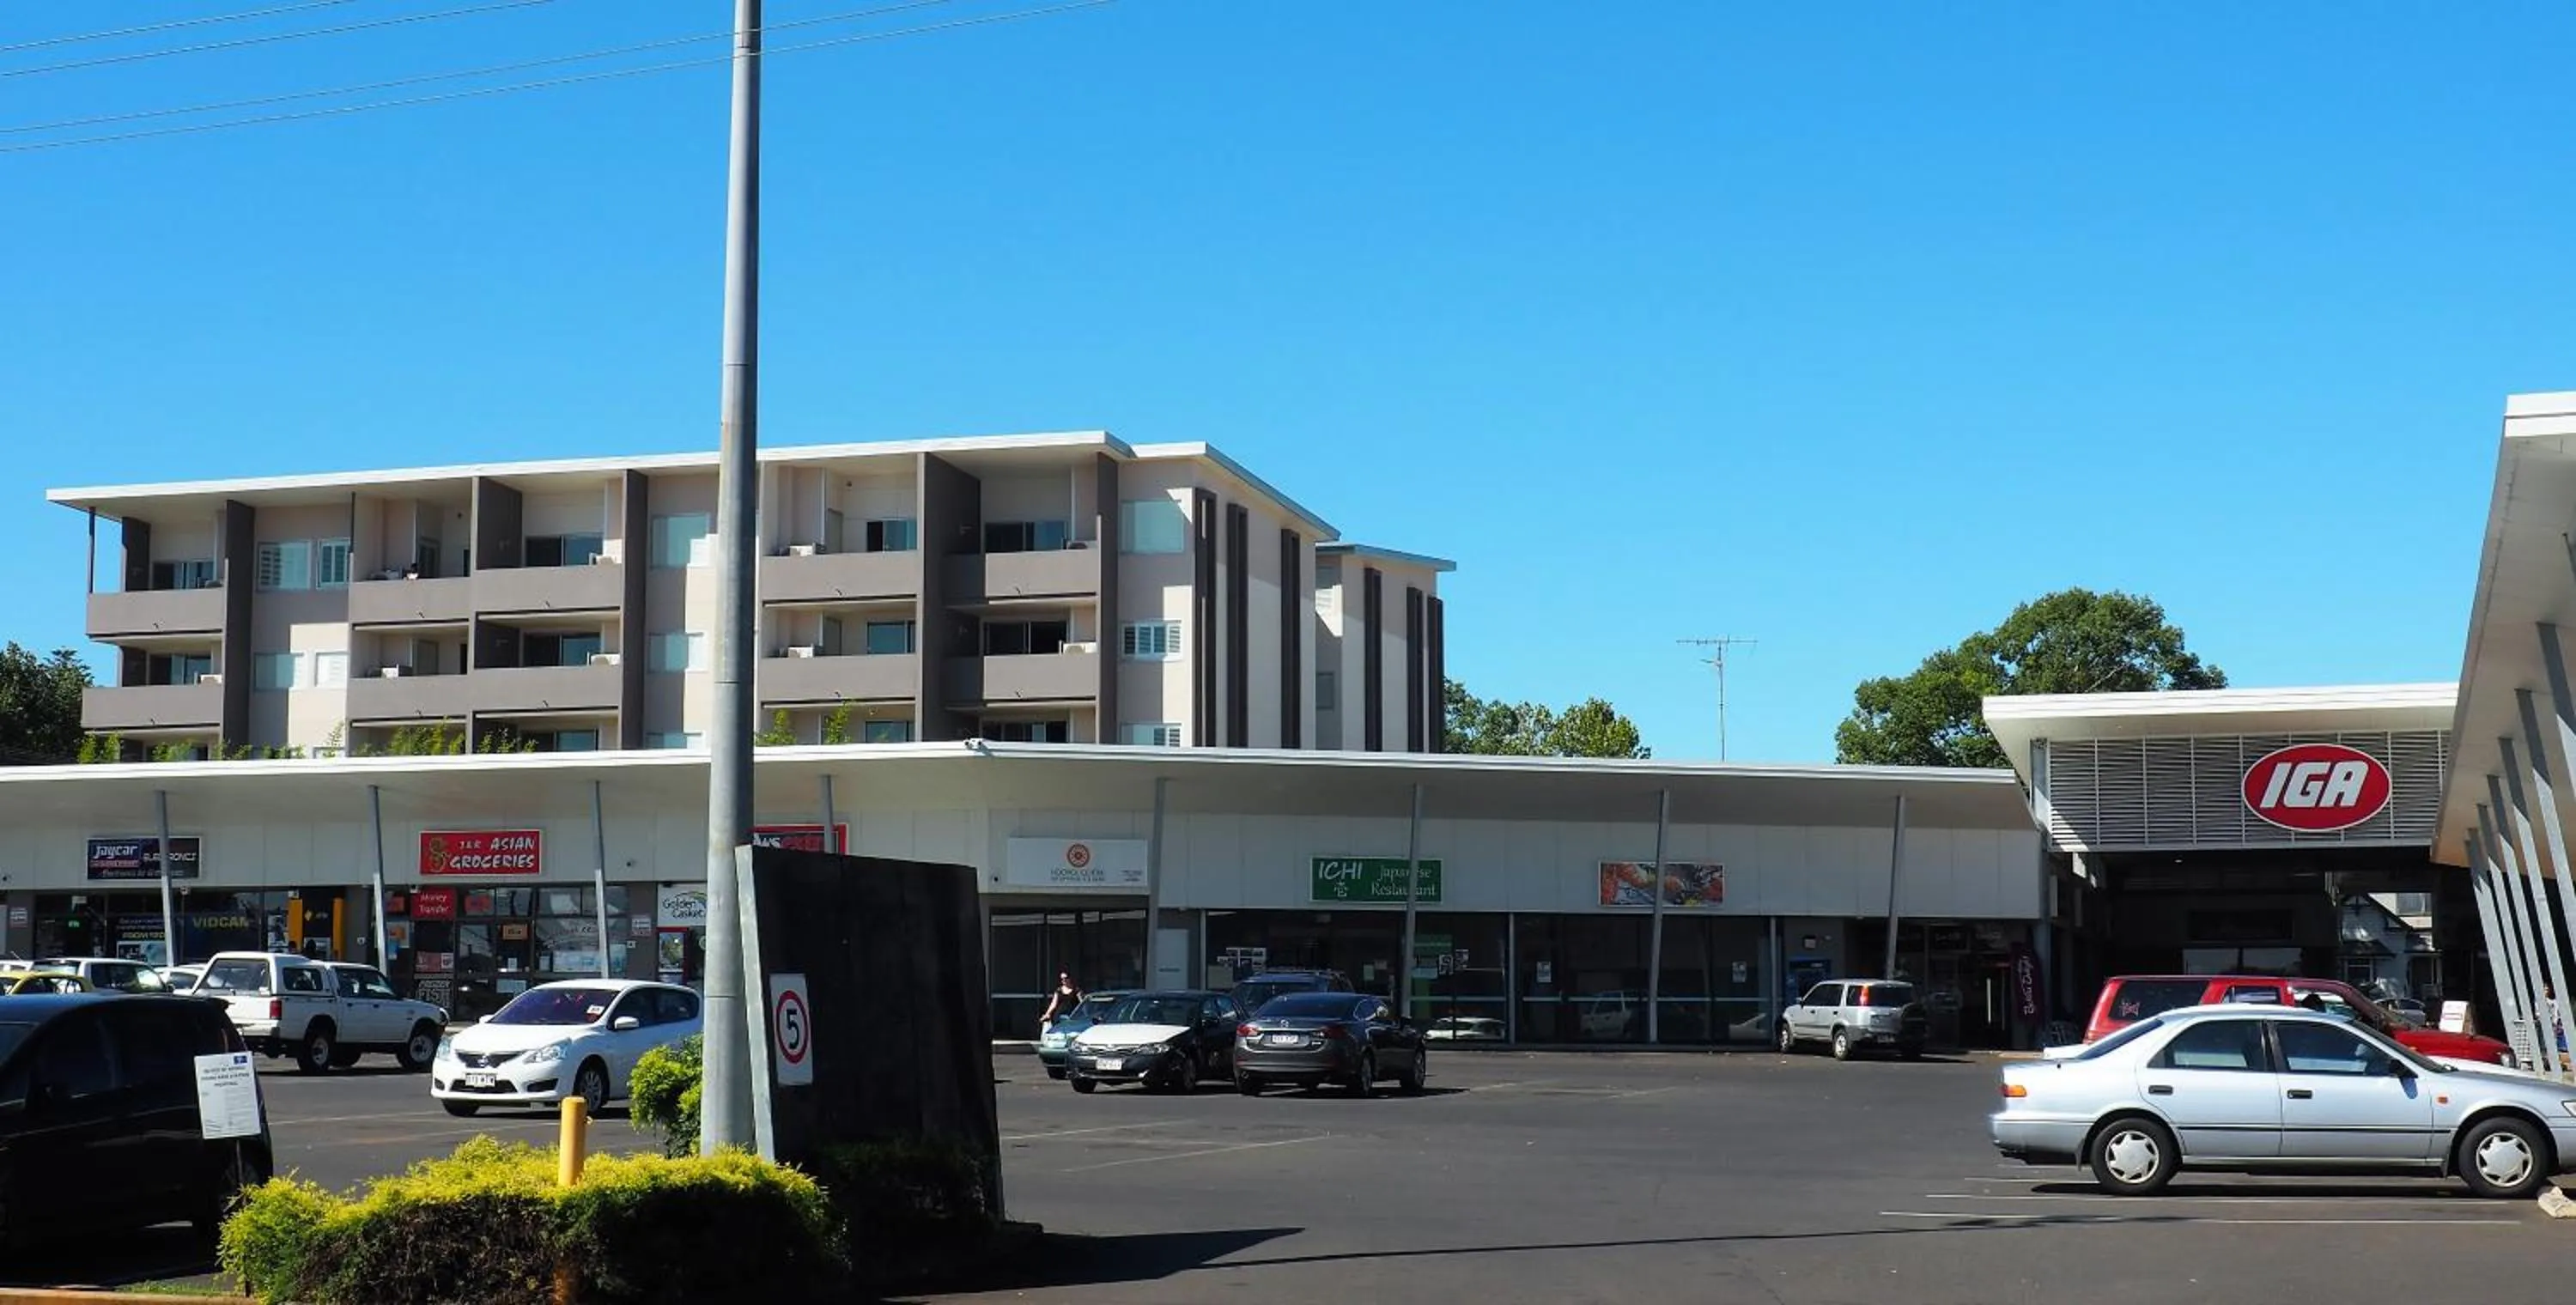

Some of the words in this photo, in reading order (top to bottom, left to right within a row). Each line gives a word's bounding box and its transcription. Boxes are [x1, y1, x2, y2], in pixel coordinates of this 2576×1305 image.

[2259, 761, 2368, 808] IGA
[490, 836, 535, 851] ASIAN
[449, 854, 535, 870] GROCERIES
[1319, 861, 1363, 880] ICHI
[1376, 865, 1432, 882] Japanse
[1371, 883, 1435, 896] Restauant
[662, 895, 696, 910] Golden
[787, 1009, 799, 1049] 5
